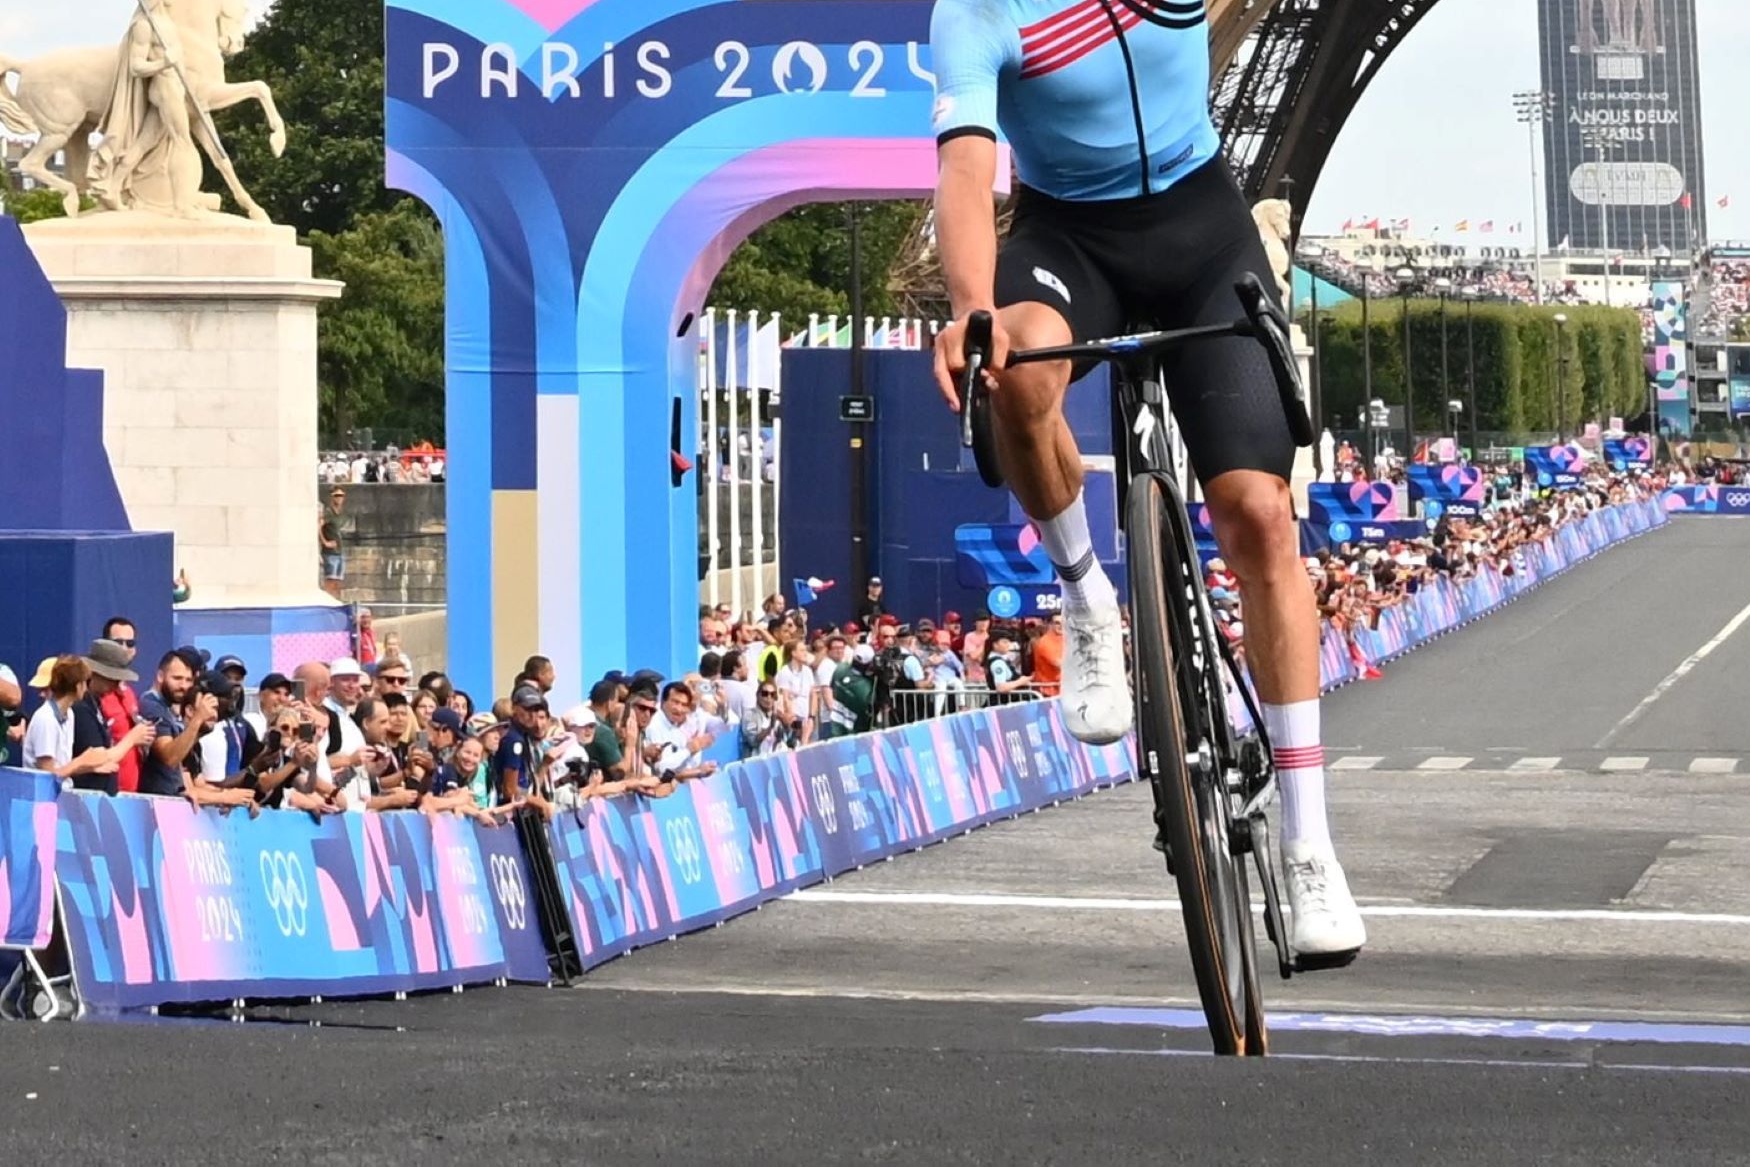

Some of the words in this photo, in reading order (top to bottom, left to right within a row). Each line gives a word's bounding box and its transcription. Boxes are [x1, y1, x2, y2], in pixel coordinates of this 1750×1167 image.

[1583, 109, 1631, 124] NOUS
[1634, 109, 1679, 124] DEUX
[1361, 527, 1385, 538] 75m
[195, 895, 244, 943] 2024
